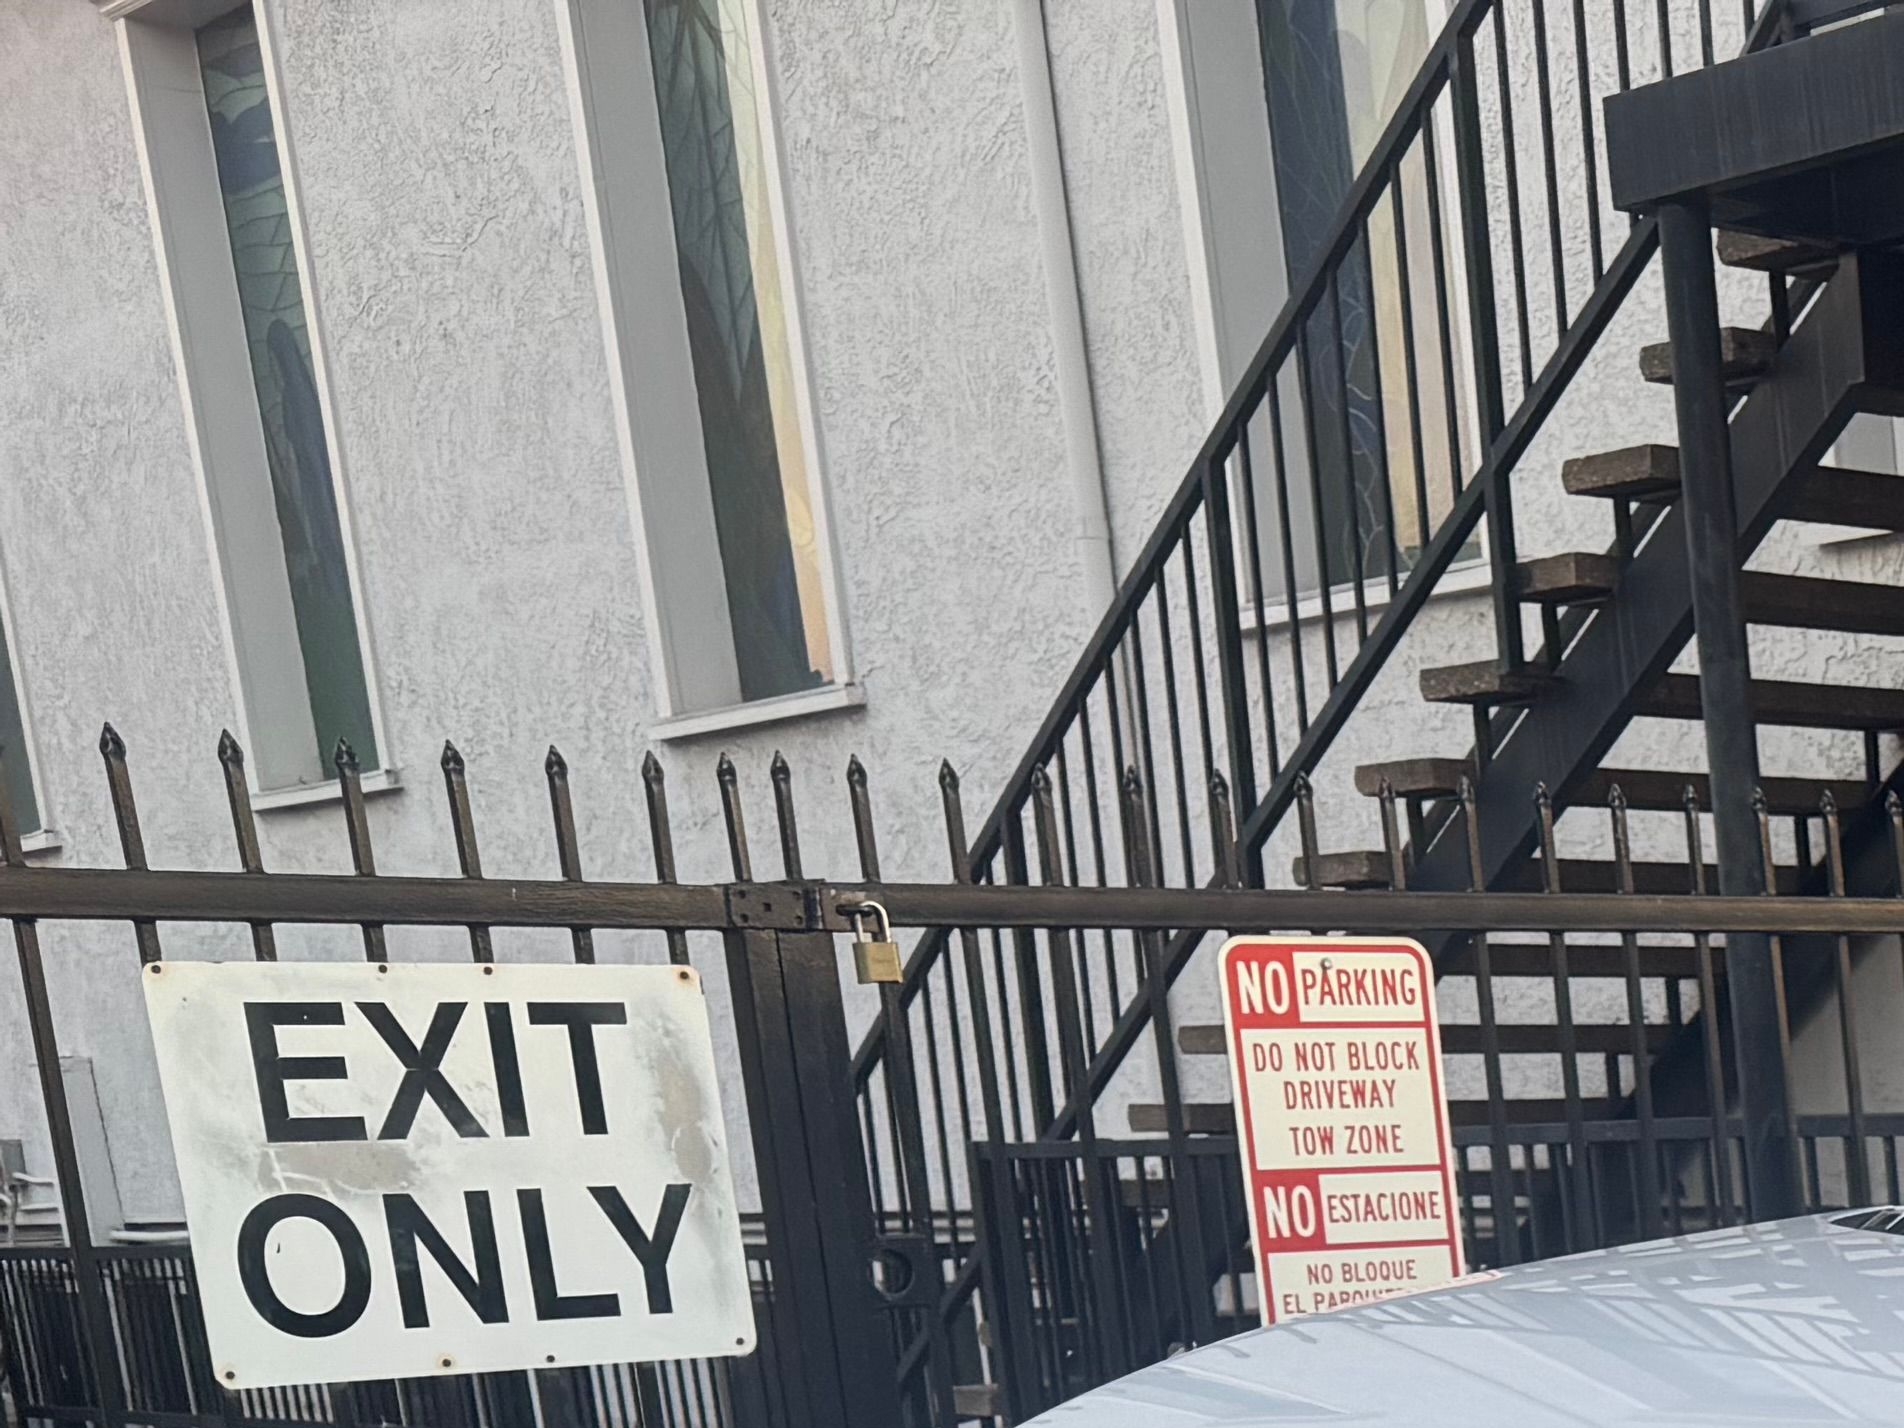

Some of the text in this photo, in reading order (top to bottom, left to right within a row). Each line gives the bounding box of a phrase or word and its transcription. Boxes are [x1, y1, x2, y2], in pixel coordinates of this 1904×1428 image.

[1235, 960, 1417, 1016] NO PARKING
[243, 1000, 628, 1143] EXIT
[1253, 1040, 1421, 1074] DO NOT BLOCK
[1283, 1078, 1397, 1111] DRIVEWAY
[1288, 1124, 1405, 1157] TOW ZONE
[1263, 1184, 1442, 1240] NO ESTACIONE
[236, 1183, 693, 1339] ONLY
[1306, 1258, 1418, 1286] NO BLOQUE
[1282, 1293, 1308, 1315] EL
